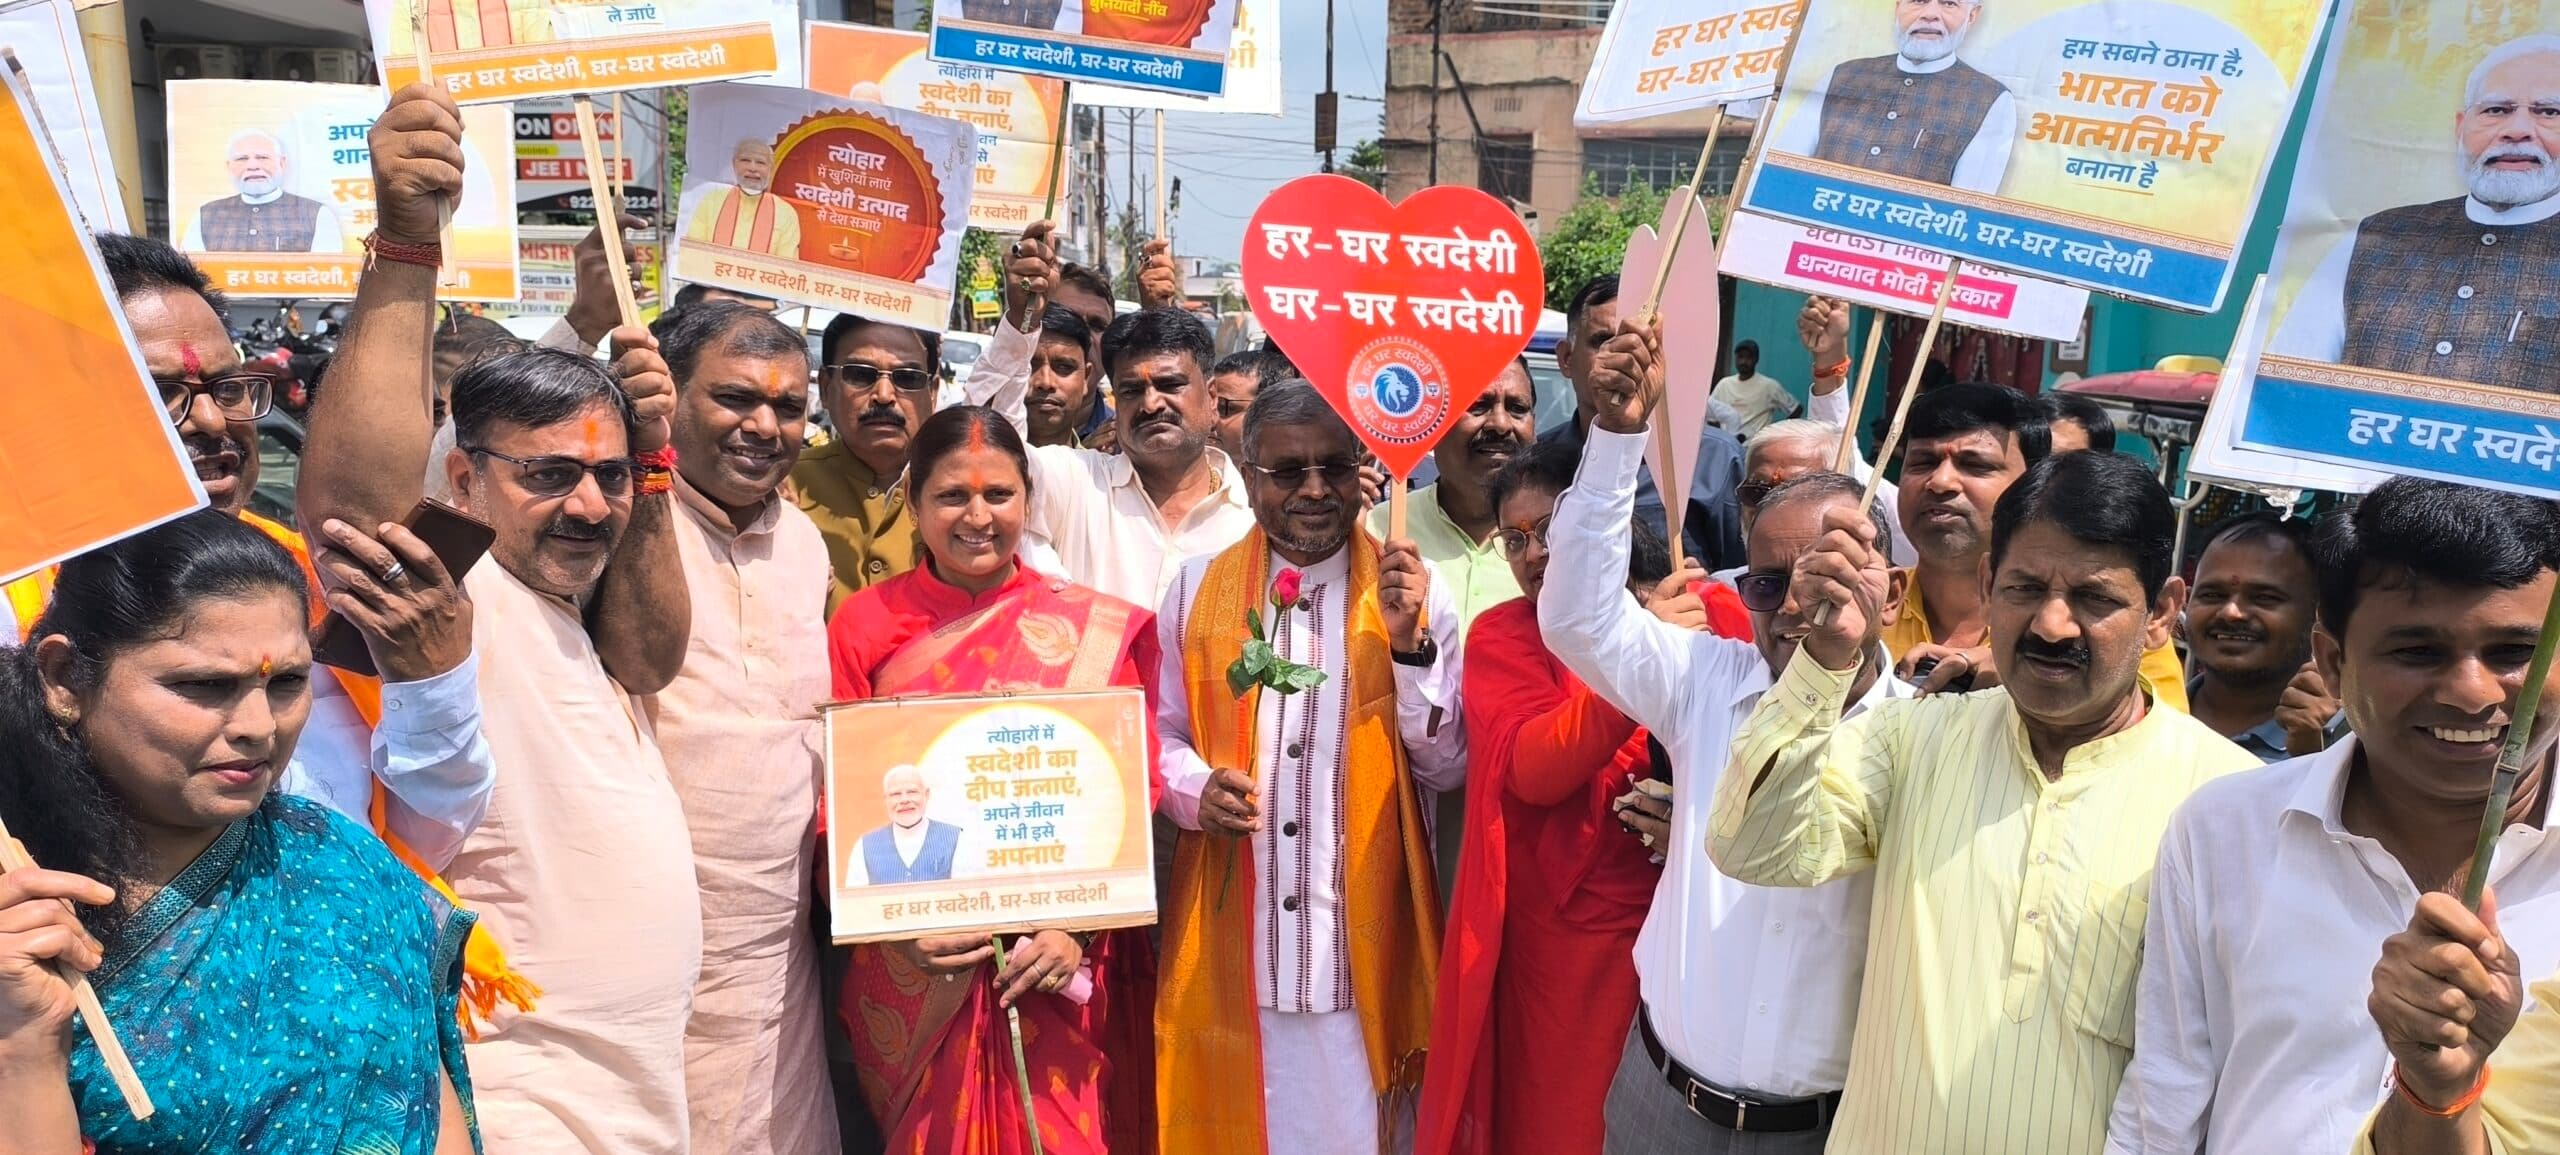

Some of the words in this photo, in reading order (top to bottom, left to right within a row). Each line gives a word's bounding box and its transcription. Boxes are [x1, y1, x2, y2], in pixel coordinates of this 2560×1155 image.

[606, 5, 622, 22] ले
[624, 4, 656, 20] जाएं
[1652, 24, 1692, 57] हर
[1695, 14, 1737, 43] घर
[444, 72, 472, 94] हर
[478, 68, 505, 88] घर
[511, 56, 586, 85] स्वदेशी,
[591, 55, 655, 77] घर-घर
[660, 45, 726, 71] स्वदेशी
[975, 39, 996, 56] हर
[998, 41, 1020, 59] घर
[1022, 43, 1076, 68] स्वदेशी,
[1080, 52, 1130, 72] घर-घर
[1132, 57, 1184, 80] स्वदेशी
[2063, 39, 2098, 59] हम
[2103, 40, 2160, 64] सबने
[2164, 49, 2219, 71] ठाना
[2221, 48, 2244, 77] है,
[1637, 56, 1730, 93] घर-घर
[919, 80, 982, 104] स्वदेशी
[986, 89, 1012, 107] का
[2059, 71, 2157, 109] भारत
[2161, 75, 2223, 117] को
[2025, 112, 2225, 164] आत्मनिर्भर
[525, 161, 560, 177] JEE
[828, 143, 886, 171] त्योहार
[2066, 157, 2136, 183] बनाना
[2138, 161, 2158, 188] है
[817, 164, 828, 178] में
[869, 176, 892, 191] लाएं
[795, 182, 855, 209] स्वदेशी
[857, 195, 910, 221] उत्पाद
[984, 205, 1028, 221] स्वदेशी
[816, 208, 828, 221] से
[829, 210, 849, 225] देश
[851, 215, 882, 232] सजाएं
[1812, 187, 1845, 211] हर
[1847, 192, 1884, 221] घर
[1885, 196, 1969, 241] स्वदेशी,
[1977, 220, 2060, 258] घर-घर
[2062, 235, 2153, 279] स्वदेशी
[1400, 225, 1517, 274] स्वदेशी
[225, 269, 250, 287] हर
[254, 270, 279, 285] घर
[282, 266, 348, 288] स्वदेशी,
[714, 262, 733, 277] हर
[736, 265, 756, 283] घर
[759, 270, 809, 294] स्वदेशी,
[814, 281, 861, 303] घर-घर
[863, 291, 912, 313] स्वदेशी
[1797, 253, 1879, 287] धन्यवाद
[1882, 267, 1930, 296] मोदी
[1263, 286, 1398, 327] घर-घर
[1407, 287, 1524, 336] स्वदेशी
[1394, 349, 1433, 376] स्वदेशी
[1403, 403, 1436, 432] स्वदेशी
[2348, 408, 2402, 444] हर
[2407, 417, 2467, 454] घर
[2473, 424, 2560, 471] स्वदे
[987, 725, 1040, 744] त्योहारों
[1042, 724, 1055, 740] में
[965, 745, 1041, 773] स्वदेशी
[1046, 750, 1077, 768] का
[965, 775, 1006, 801] दीप
[1011, 770, 1082, 797] जलाएं,
[984, 803, 1020, 821] अपने
[1024, 801, 1065, 818] जीवन
[995, 824, 1007, 841] में
[1011, 822, 1028, 839] भी
[1031, 821, 1055, 841] इसे
[986, 839, 1066, 868] अपनाएं
[882, 902, 903, 920] हर
[908, 900, 930, 916] घर
[935, 891, 995, 913] स्वदेशी,
[1000, 890, 1050, 908] घर-घर
[1054, 882, 1109, 904] स्वदेशी
